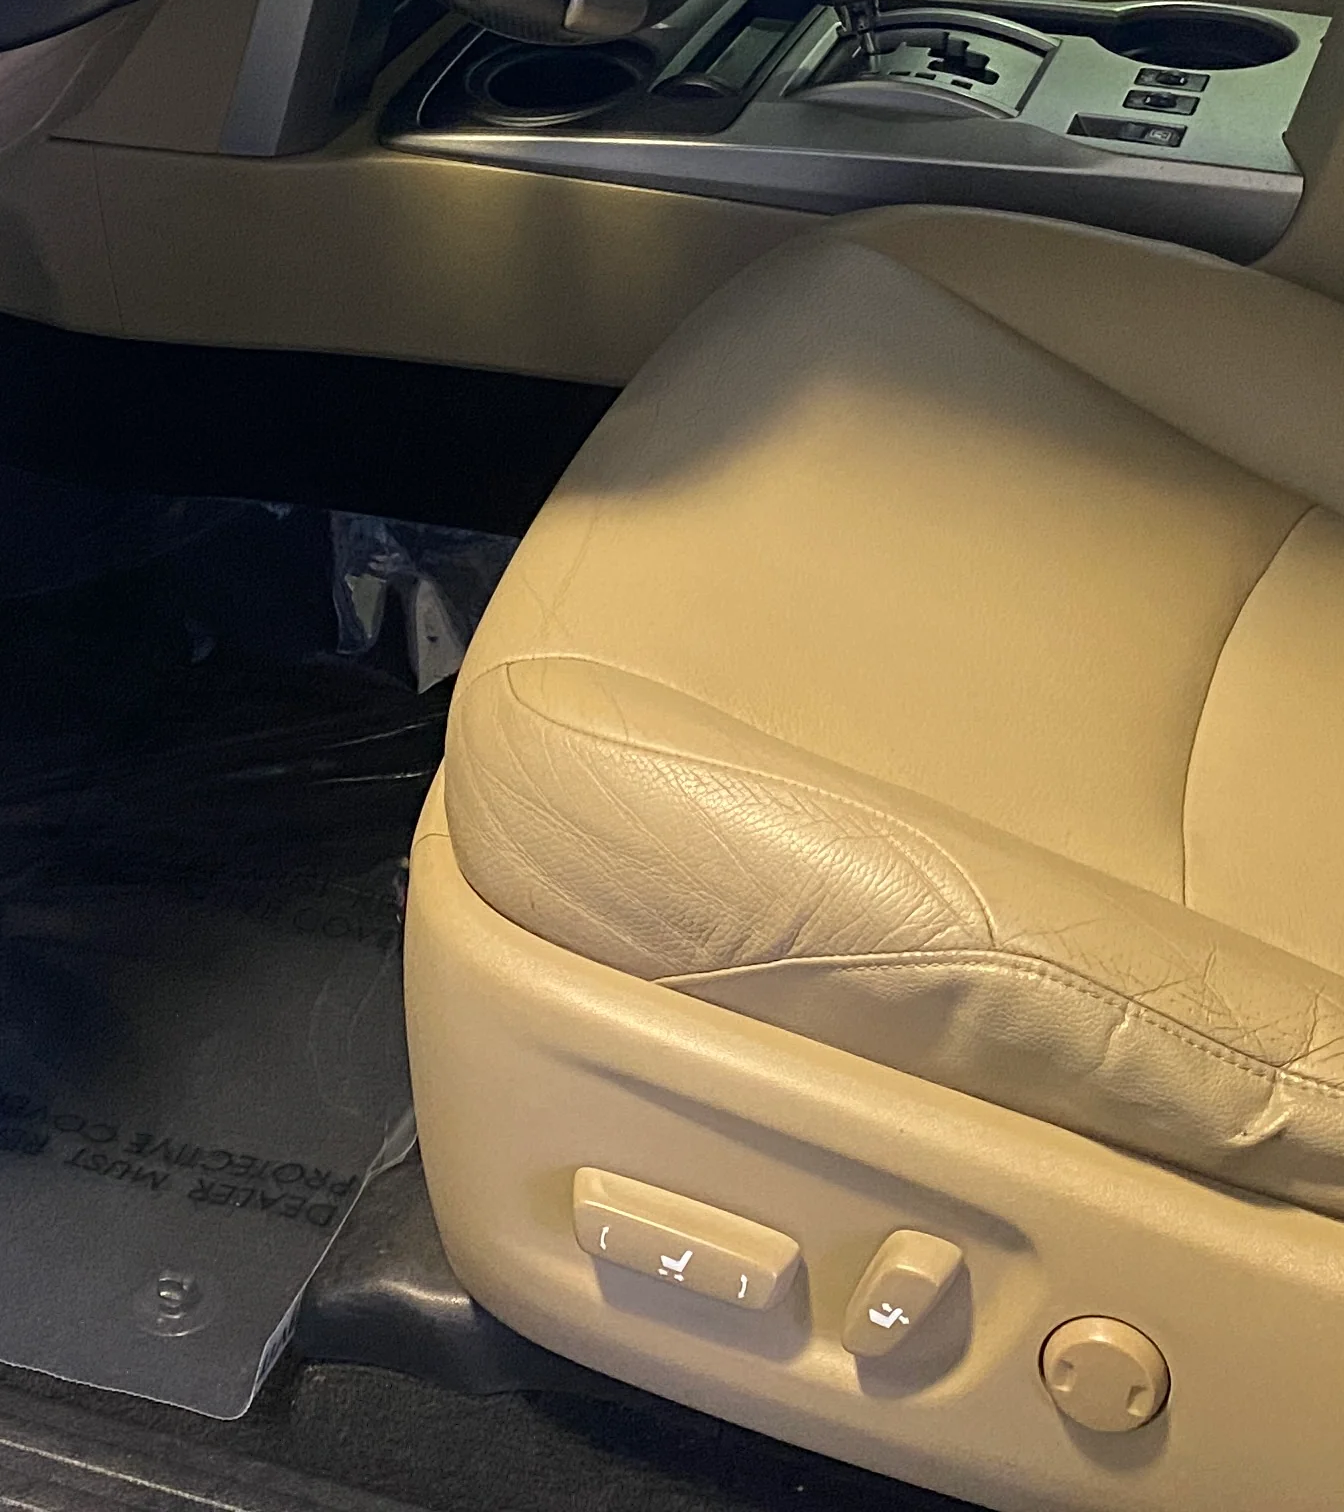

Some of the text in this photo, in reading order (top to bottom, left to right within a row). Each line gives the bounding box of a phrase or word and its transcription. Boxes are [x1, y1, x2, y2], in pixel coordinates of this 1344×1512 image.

[61, 1147, 170, 1192] MUST
[123, 1132, 359, 1197] PROTECTIVE
[188, 1177, 338, 1228] DEALER
